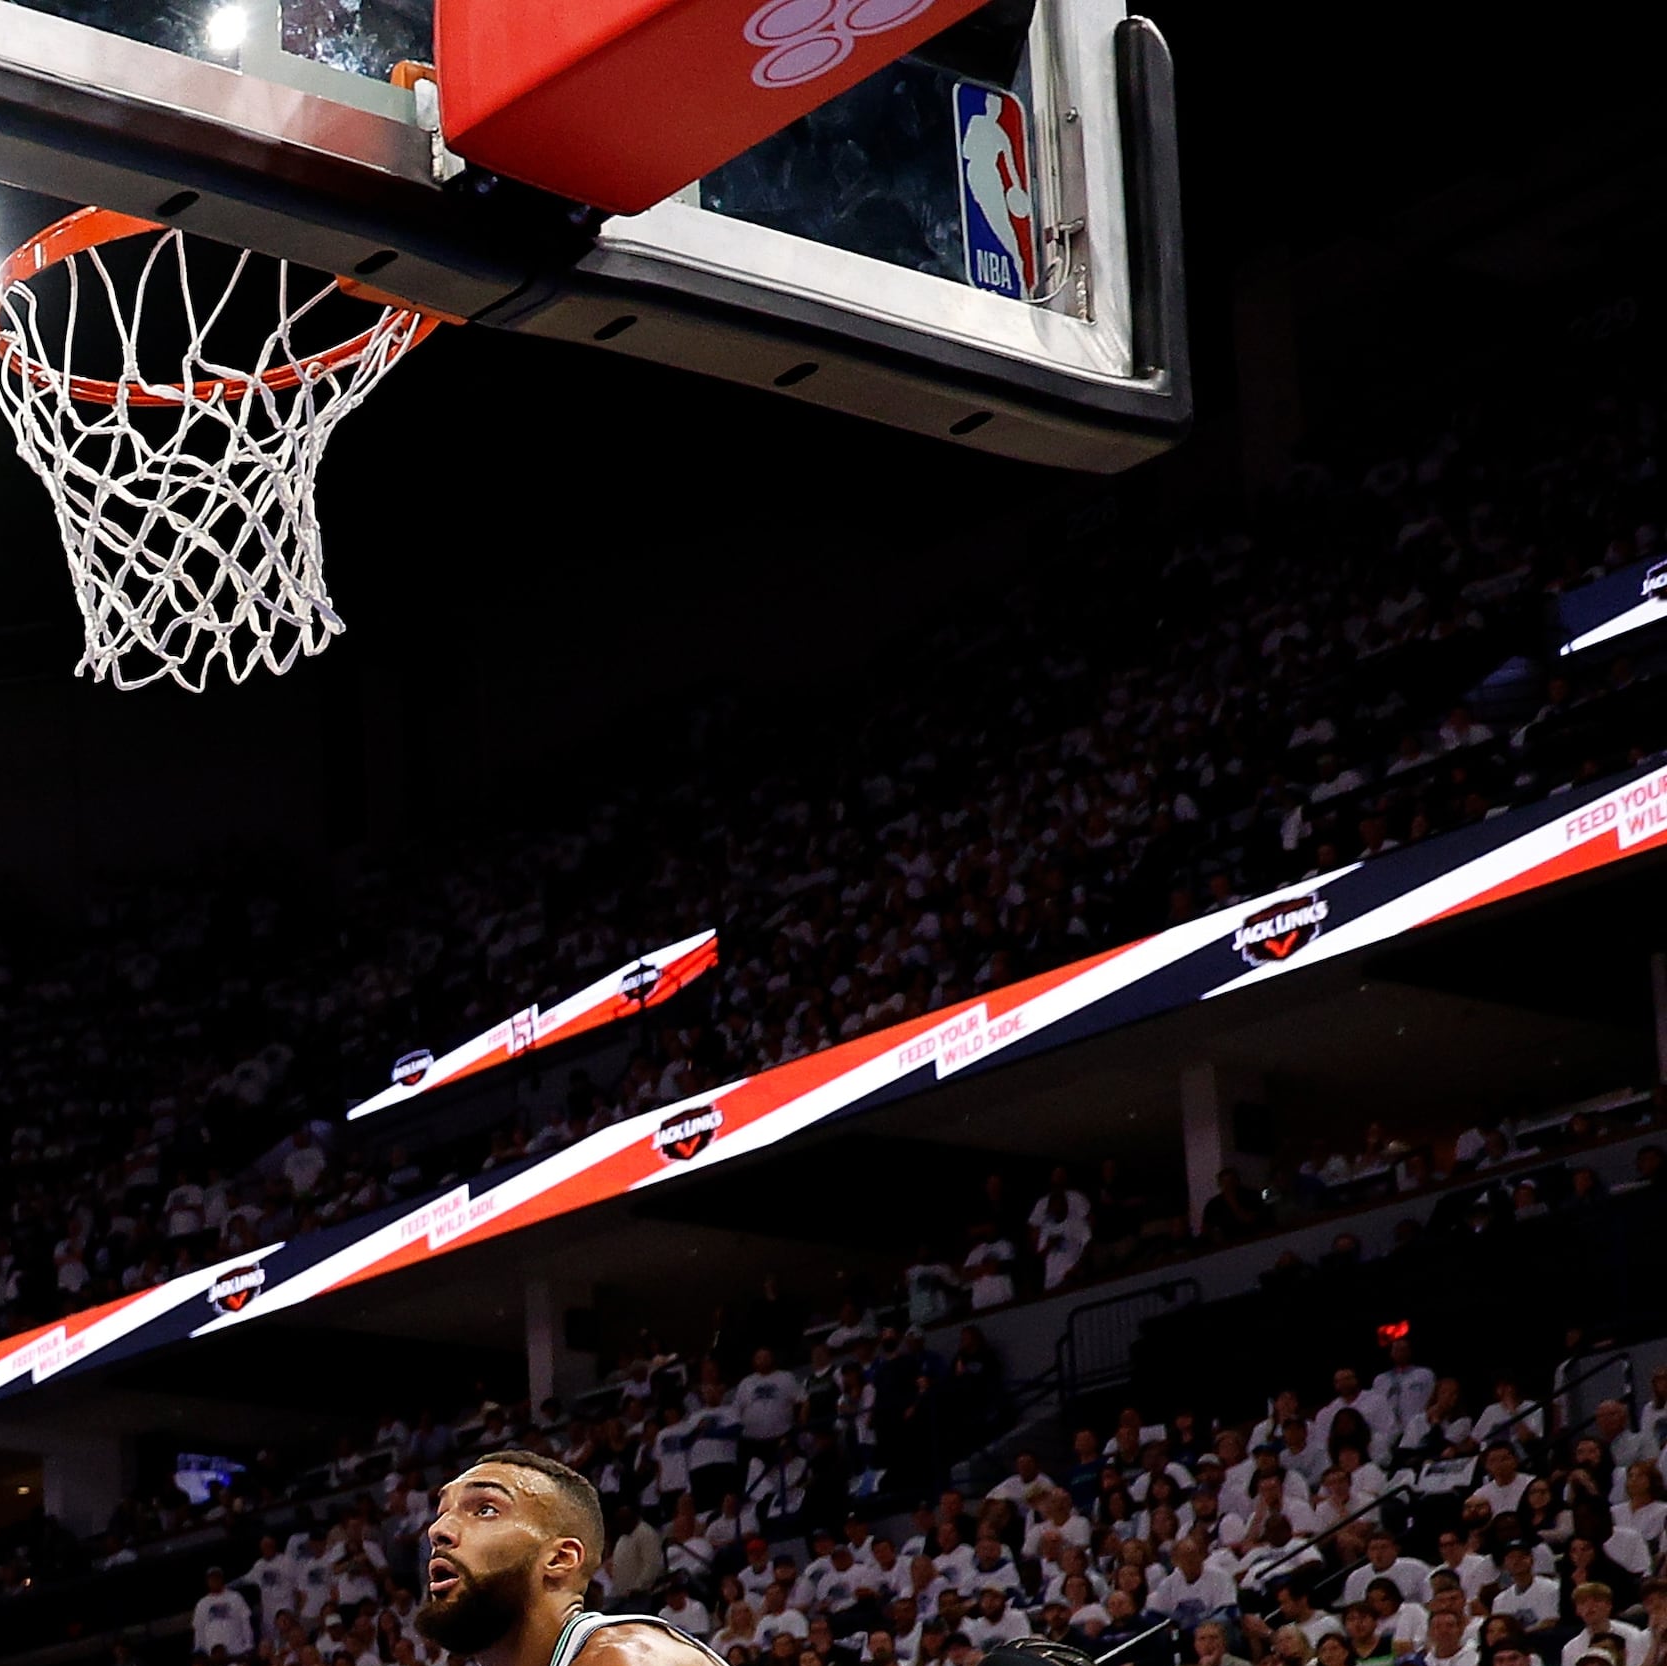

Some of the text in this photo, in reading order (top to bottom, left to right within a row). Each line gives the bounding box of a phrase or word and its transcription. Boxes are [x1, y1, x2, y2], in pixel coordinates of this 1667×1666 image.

[976, 249, 1013, 290] NBA
[1566, 803, 1617, 842] FEED
[1626, 801, 1667, 838] WIL
[898, 1014, 979, 1070] FEED YOUR
[944, 1033, 984, 1066] WILD
